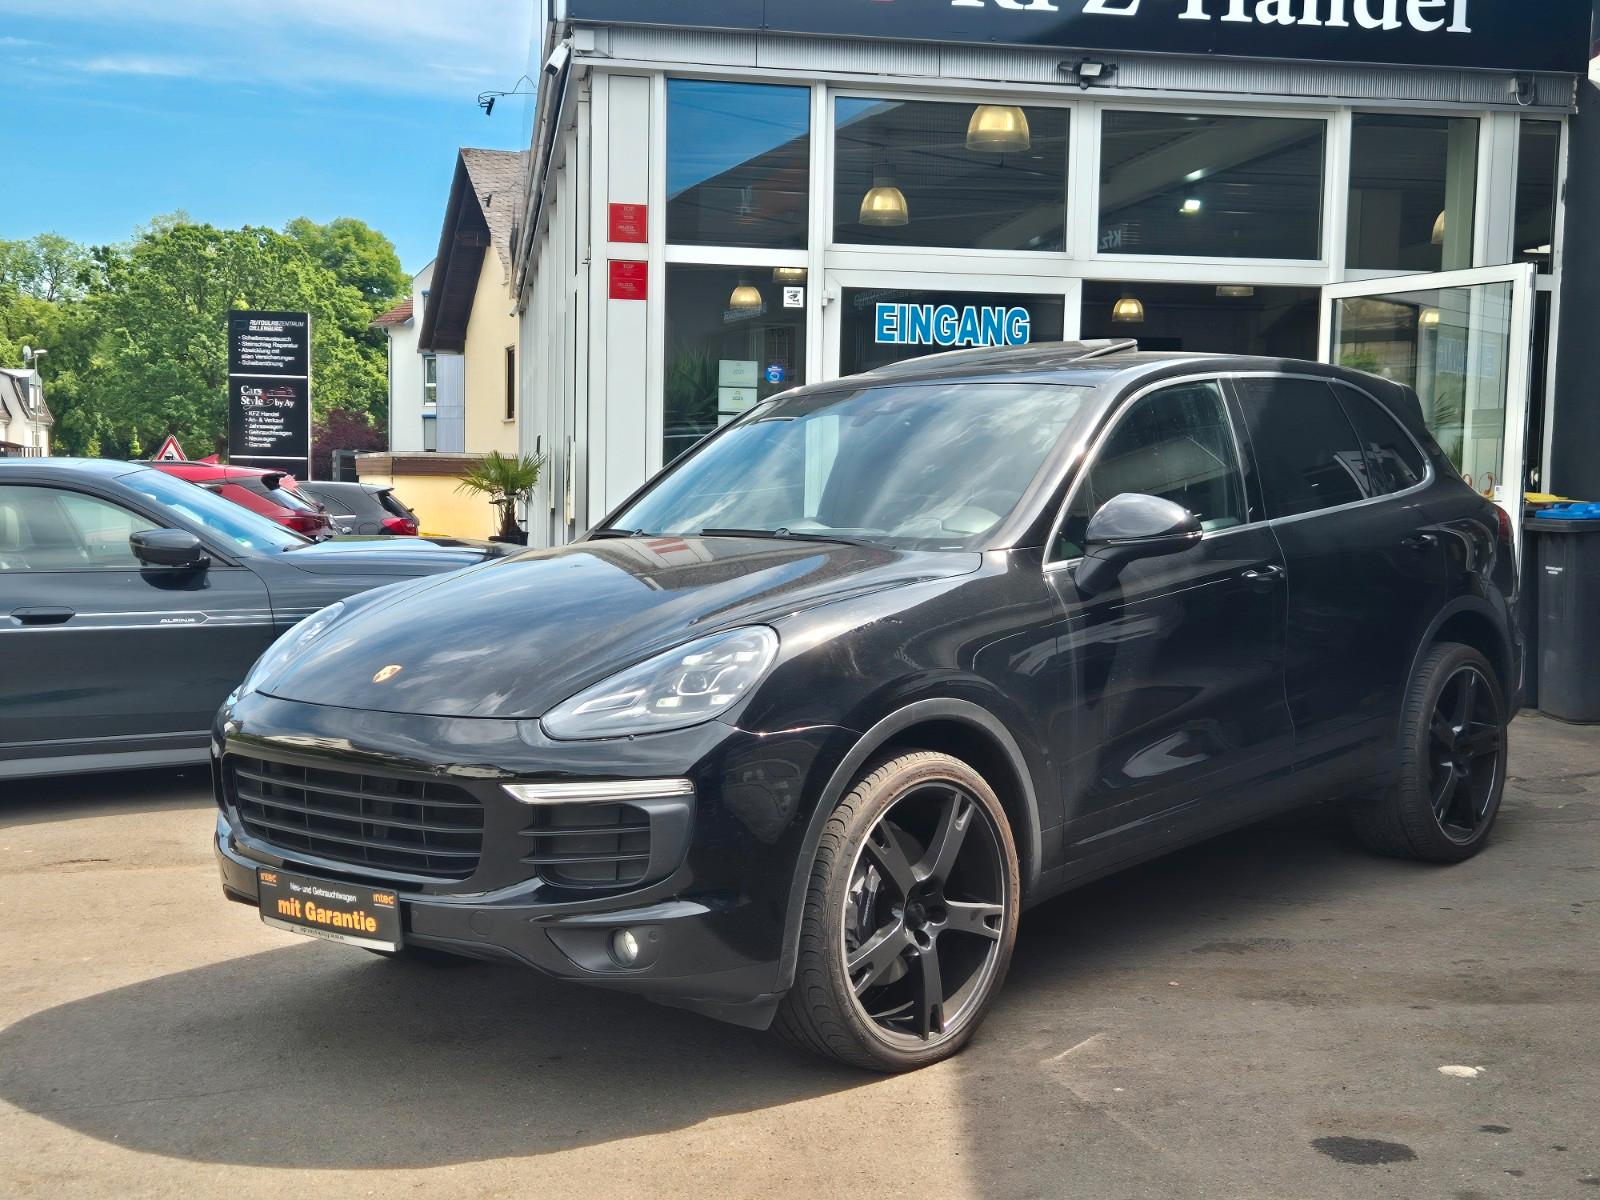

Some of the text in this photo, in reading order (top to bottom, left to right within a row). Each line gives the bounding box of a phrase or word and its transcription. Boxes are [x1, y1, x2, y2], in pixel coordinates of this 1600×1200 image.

[875, 302, 1030, 346] EINGANG
[240, 385, 263, 395] Cars
[240, 395, 295, 409] Style by Ay
[289, 882, 357, 903] Neu- und Gebrauchtwagen
[278, 897, 377, 932] mit Garantie
